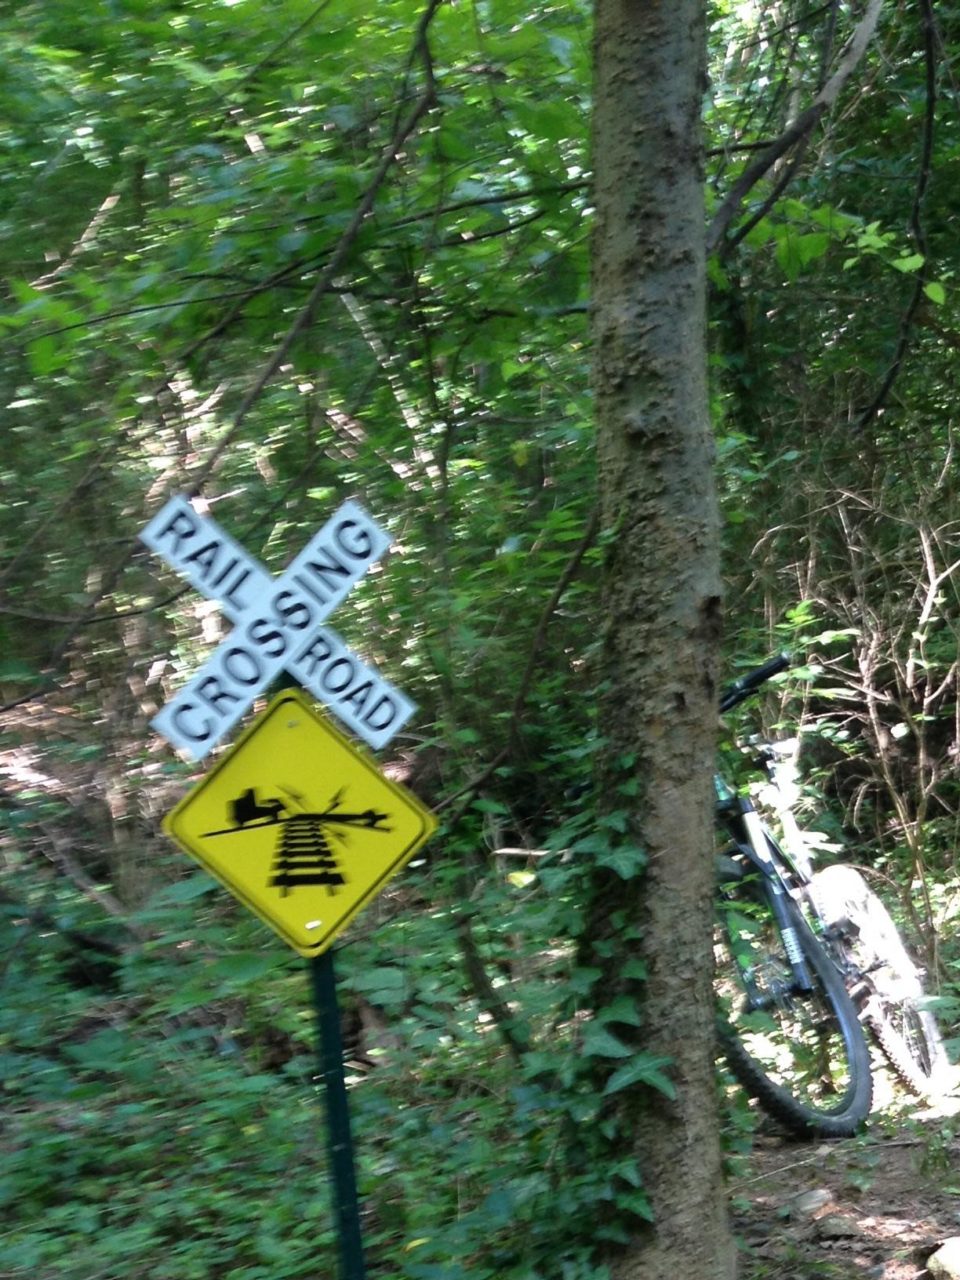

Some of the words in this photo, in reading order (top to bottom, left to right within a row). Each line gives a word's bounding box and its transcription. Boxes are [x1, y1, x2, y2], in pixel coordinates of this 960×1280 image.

[156, 510, 251, 610] RAIL
[296, 636, 396, 730] ROAD
[172, 519, 374, 741] CROSSING
